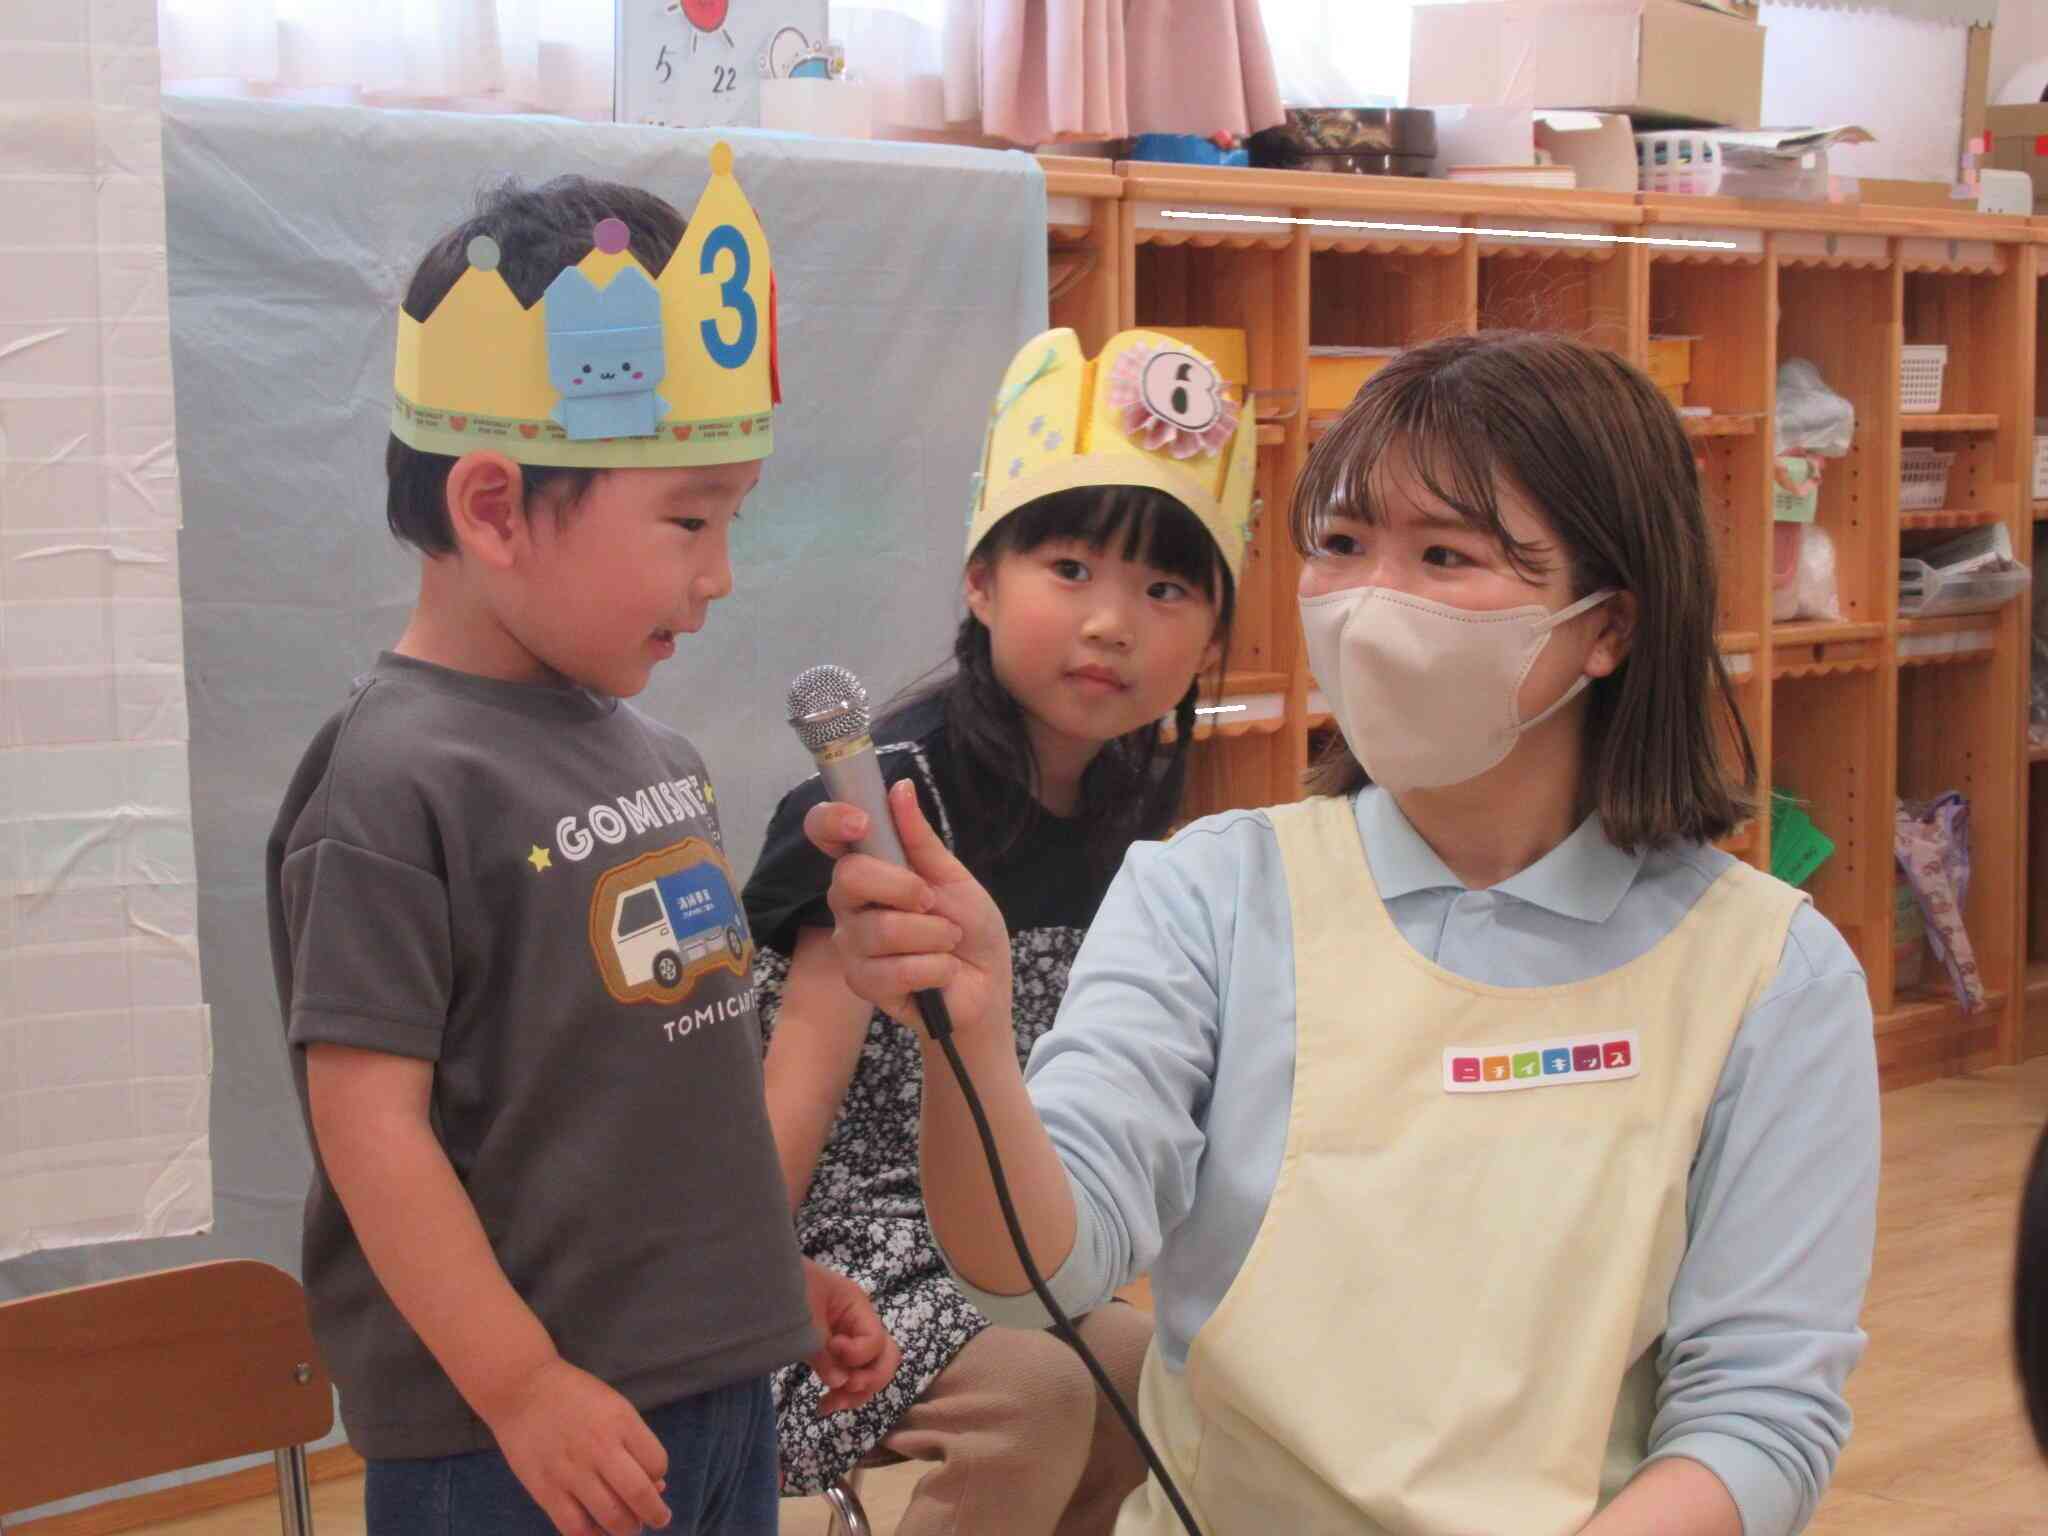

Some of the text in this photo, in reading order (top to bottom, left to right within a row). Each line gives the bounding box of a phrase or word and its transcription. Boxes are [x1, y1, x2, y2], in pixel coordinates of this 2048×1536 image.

[656, 45, 737, 93] 5 22
[700, 224, 757, 369] 3
